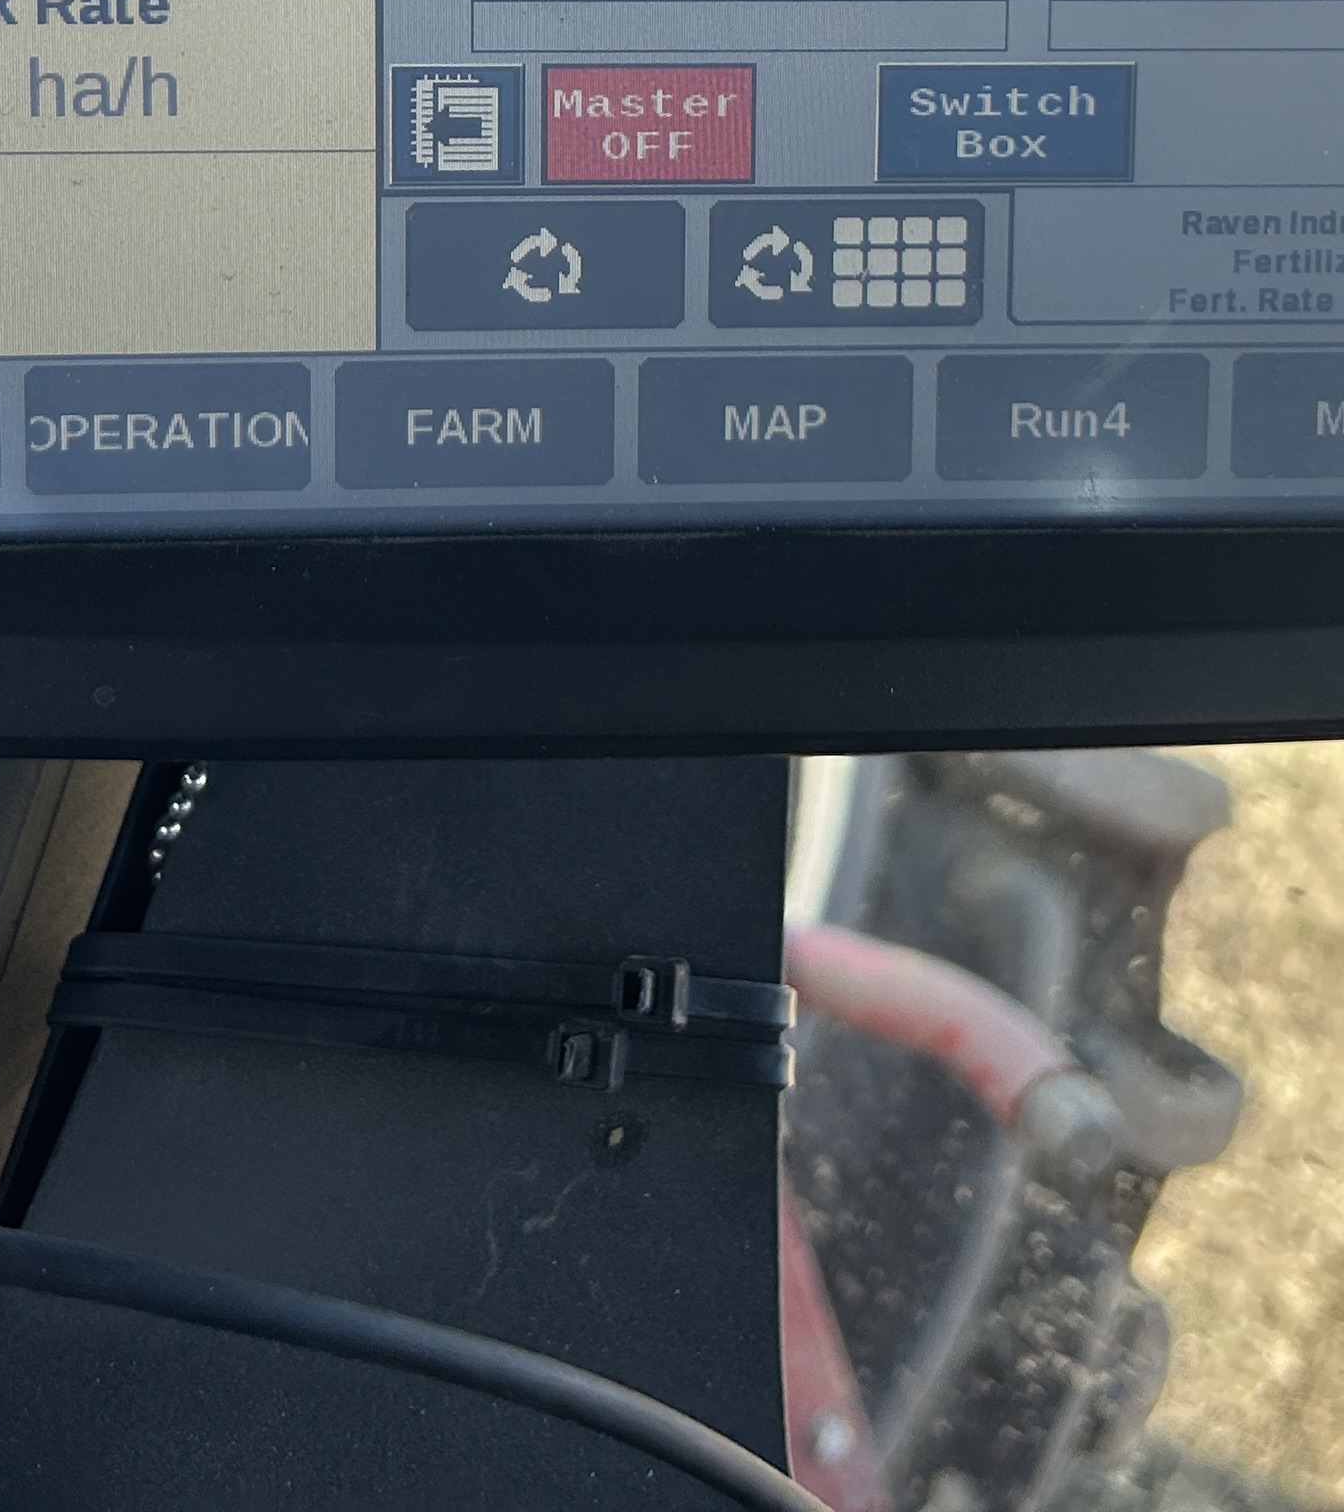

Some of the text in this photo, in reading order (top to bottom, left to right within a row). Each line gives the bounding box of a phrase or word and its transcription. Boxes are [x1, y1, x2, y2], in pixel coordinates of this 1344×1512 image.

[29, 55, 180, 117] ha/h
[908, 85, 1097, 118] Switch
[552, 87, 739, 119] Master
[600, 129, 695, 162] OFF
[955, 129, 1048, 160] Box
[1181, 209, 1282, 237] Raven
[1167, 287, 1248, 315] Fert.
[1258, 287, 1335, 314] Rate
[406, 406, 544, 447] FARM
[723, 402, 828, 442] MAP
[1008, 399, 1131, 440] Run4
